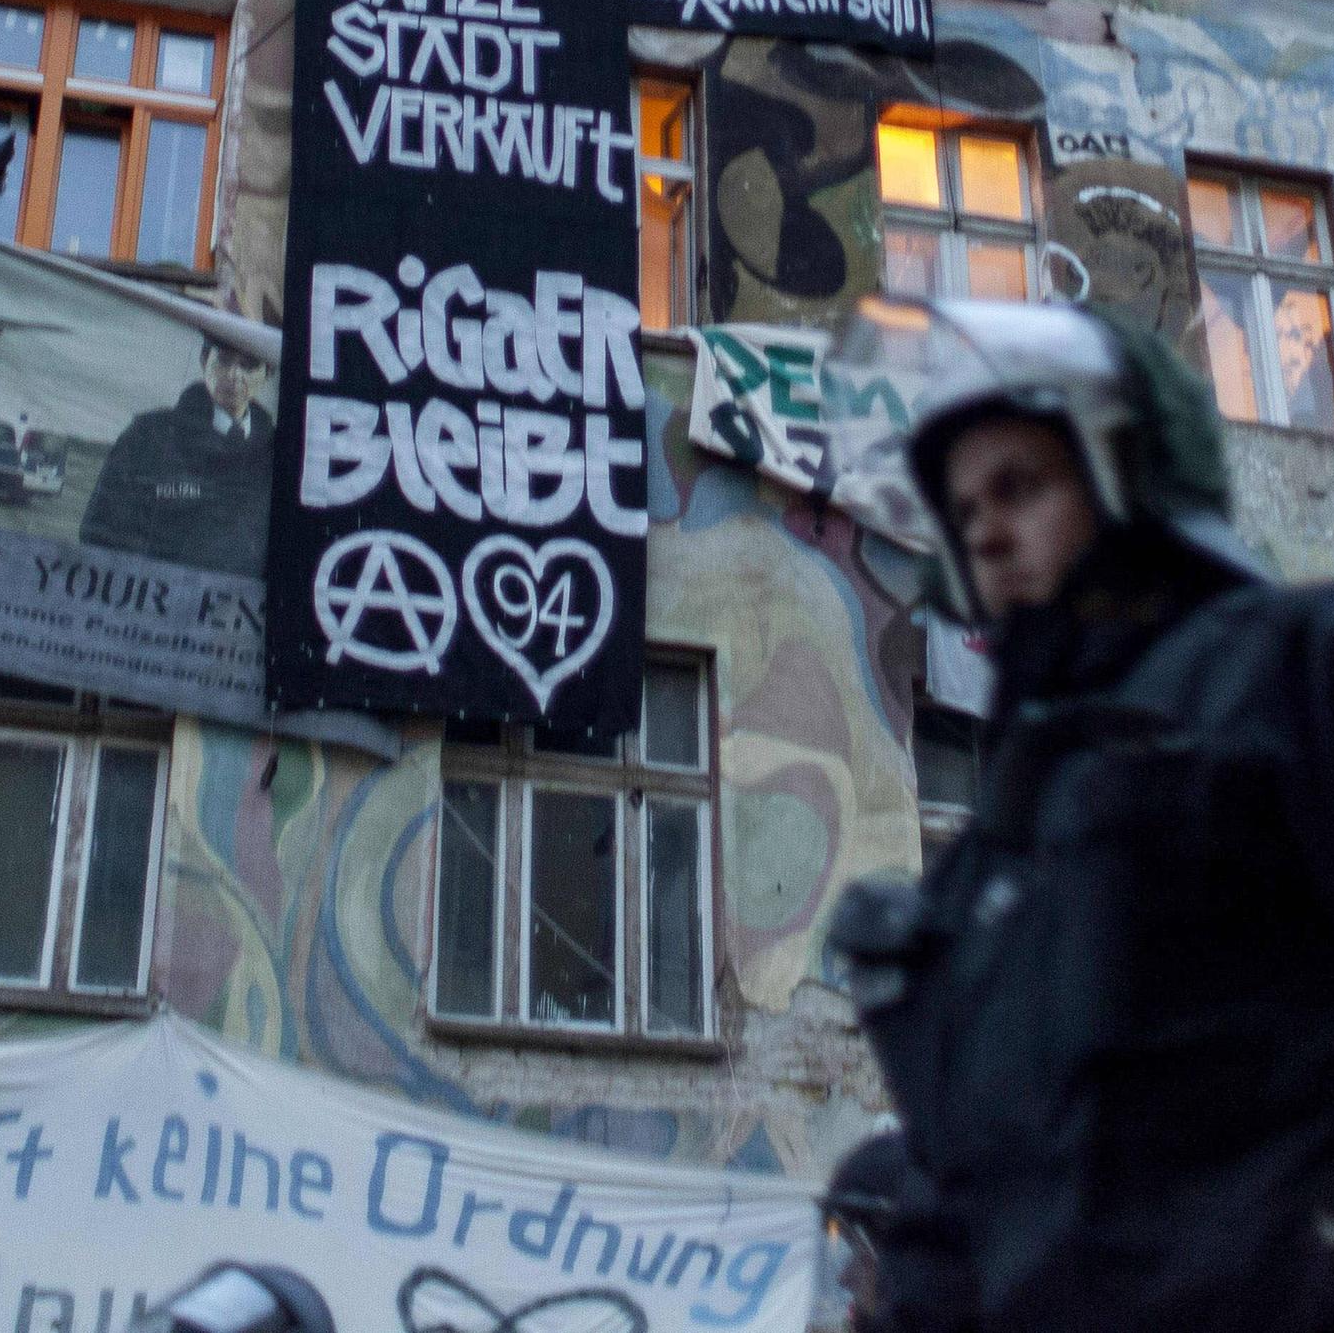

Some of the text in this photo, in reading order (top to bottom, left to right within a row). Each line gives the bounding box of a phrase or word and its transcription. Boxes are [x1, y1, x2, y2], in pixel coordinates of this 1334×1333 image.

[327, 3, 560, 96] STADT
[155, 481, 201, 500] POLIZEI
[34, 555, 169, 616] YOUR
[493, 566, 586, 657] 94
[94, 1070, 335, 1220] keine
[367, 1130, 790, 1328] Ordnung
